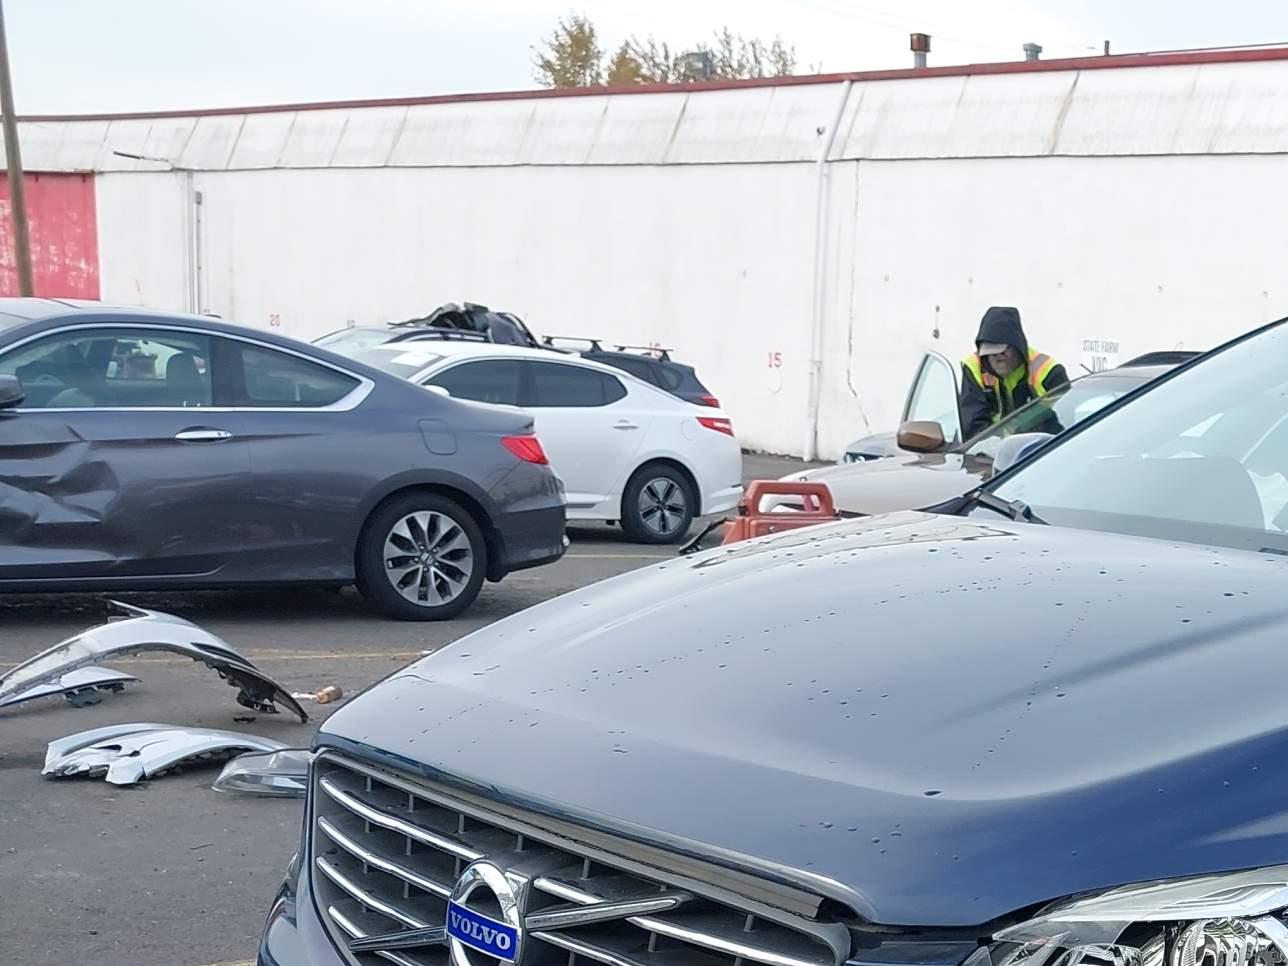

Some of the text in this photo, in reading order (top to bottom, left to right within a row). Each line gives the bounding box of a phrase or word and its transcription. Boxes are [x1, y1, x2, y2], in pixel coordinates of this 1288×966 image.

[270, 314, 280, 327] 20
[1082, 340, 1099, 353] STATE
[768, 352, 782, 368] 15
[450, 910, 511, 950] VOLVO
